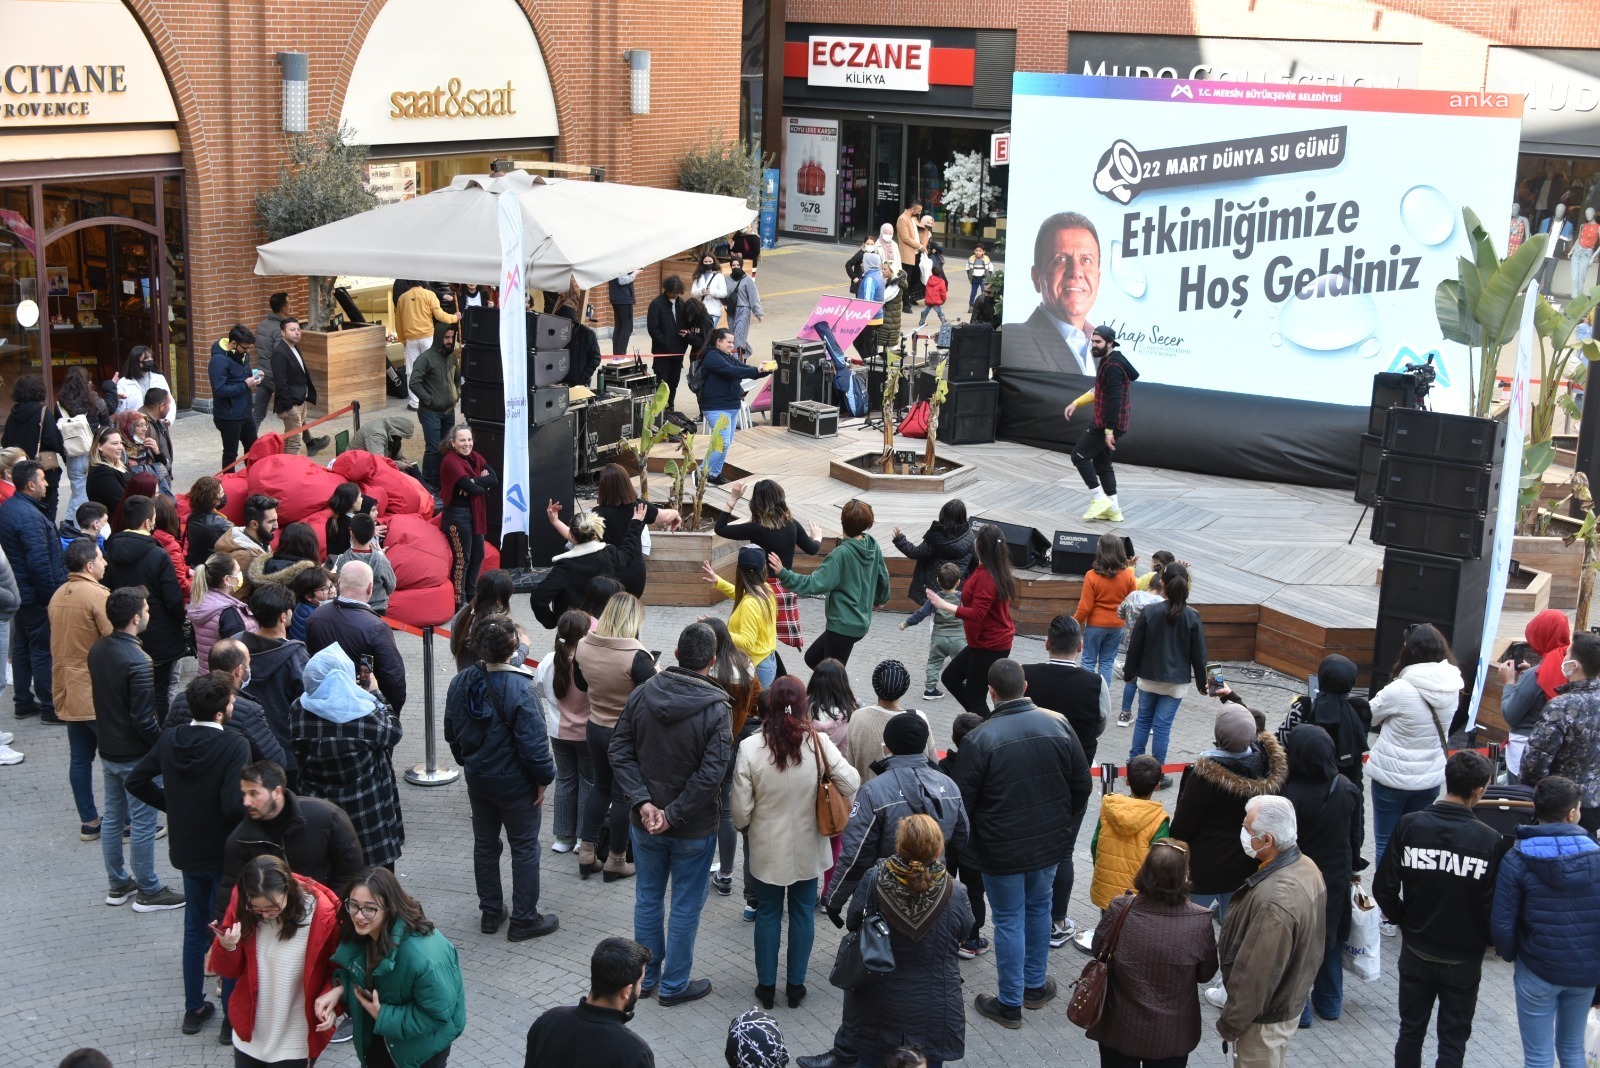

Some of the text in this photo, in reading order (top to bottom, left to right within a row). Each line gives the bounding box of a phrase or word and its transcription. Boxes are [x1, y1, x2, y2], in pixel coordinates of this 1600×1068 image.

[812, 41, 922, 70] ECZANE
[0, 64, 127, 95] CITANE
[845, 73, 886, 85] KİLİKYA
[0, 102, 90, 118] ROVENCE
[390, 77, 517, 119] saat&saat
[997, 141, 1006, 159] E
[1142, 133, 1340, 178] 22 MART DÜNYA SU GÜNÜ
[800, 201, 821, 214] %78
[1121, 190, 1360, 260] Etkinliğimize
[1178, 244, 1423, 319] Hoş Geldiniz
[1400, 846, 1489, 880] MSTAFF
